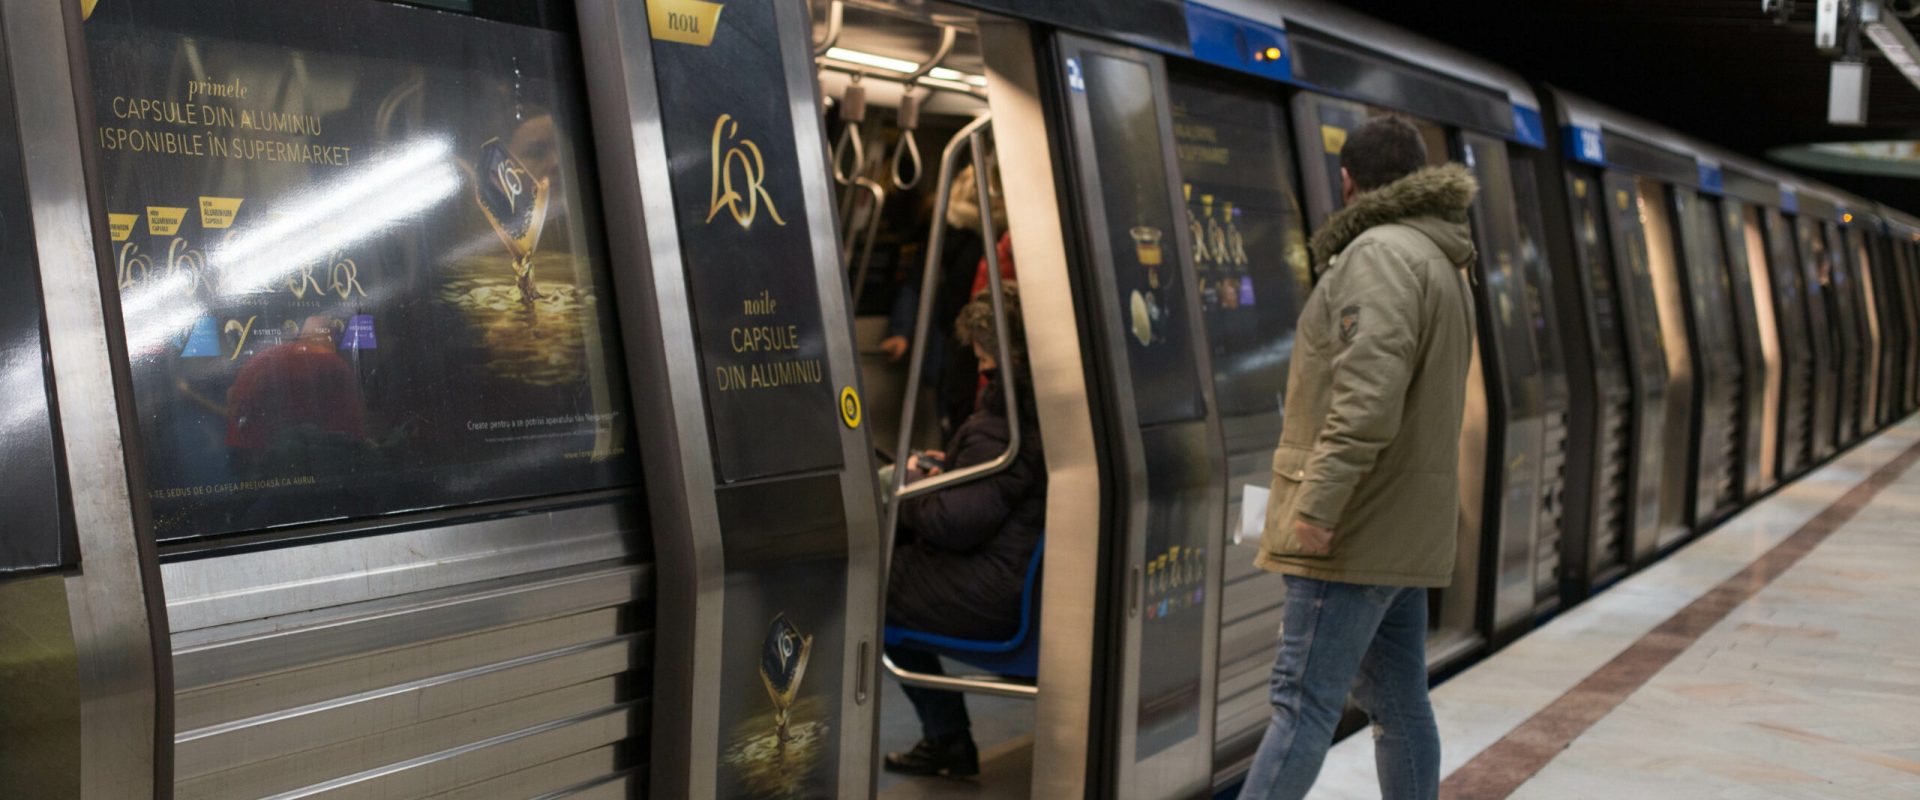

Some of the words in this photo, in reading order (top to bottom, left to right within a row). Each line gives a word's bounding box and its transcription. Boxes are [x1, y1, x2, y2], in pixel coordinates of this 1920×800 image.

[668, 11, 700, 34] nou
[188, 76, 248, 101] primele
[112, 96, 198, 125] CAPSULE
[202, 105, 235, 128] DIN
[240, 109, 322, 136] ALUMINIU
[207, 132, 228, 158] ÎN
[232, 138, 350, 166] SUPERMARKET
[743, 289, 777, 316] noile
[731, 325, 799, 353] CAPSULE
[716, 365, 746, 391] DIN
[751, 359, 822, 388] ALUMINIU
[166, 487, 192, 498] SEDUS
[193, 485, 203, 496] DE
[205, 484, 212, 494] O
[214, 482, 239, 494] CAFEA
[281, 477, 292, 487] CA
[293, 475, 316, 485] AURUL
